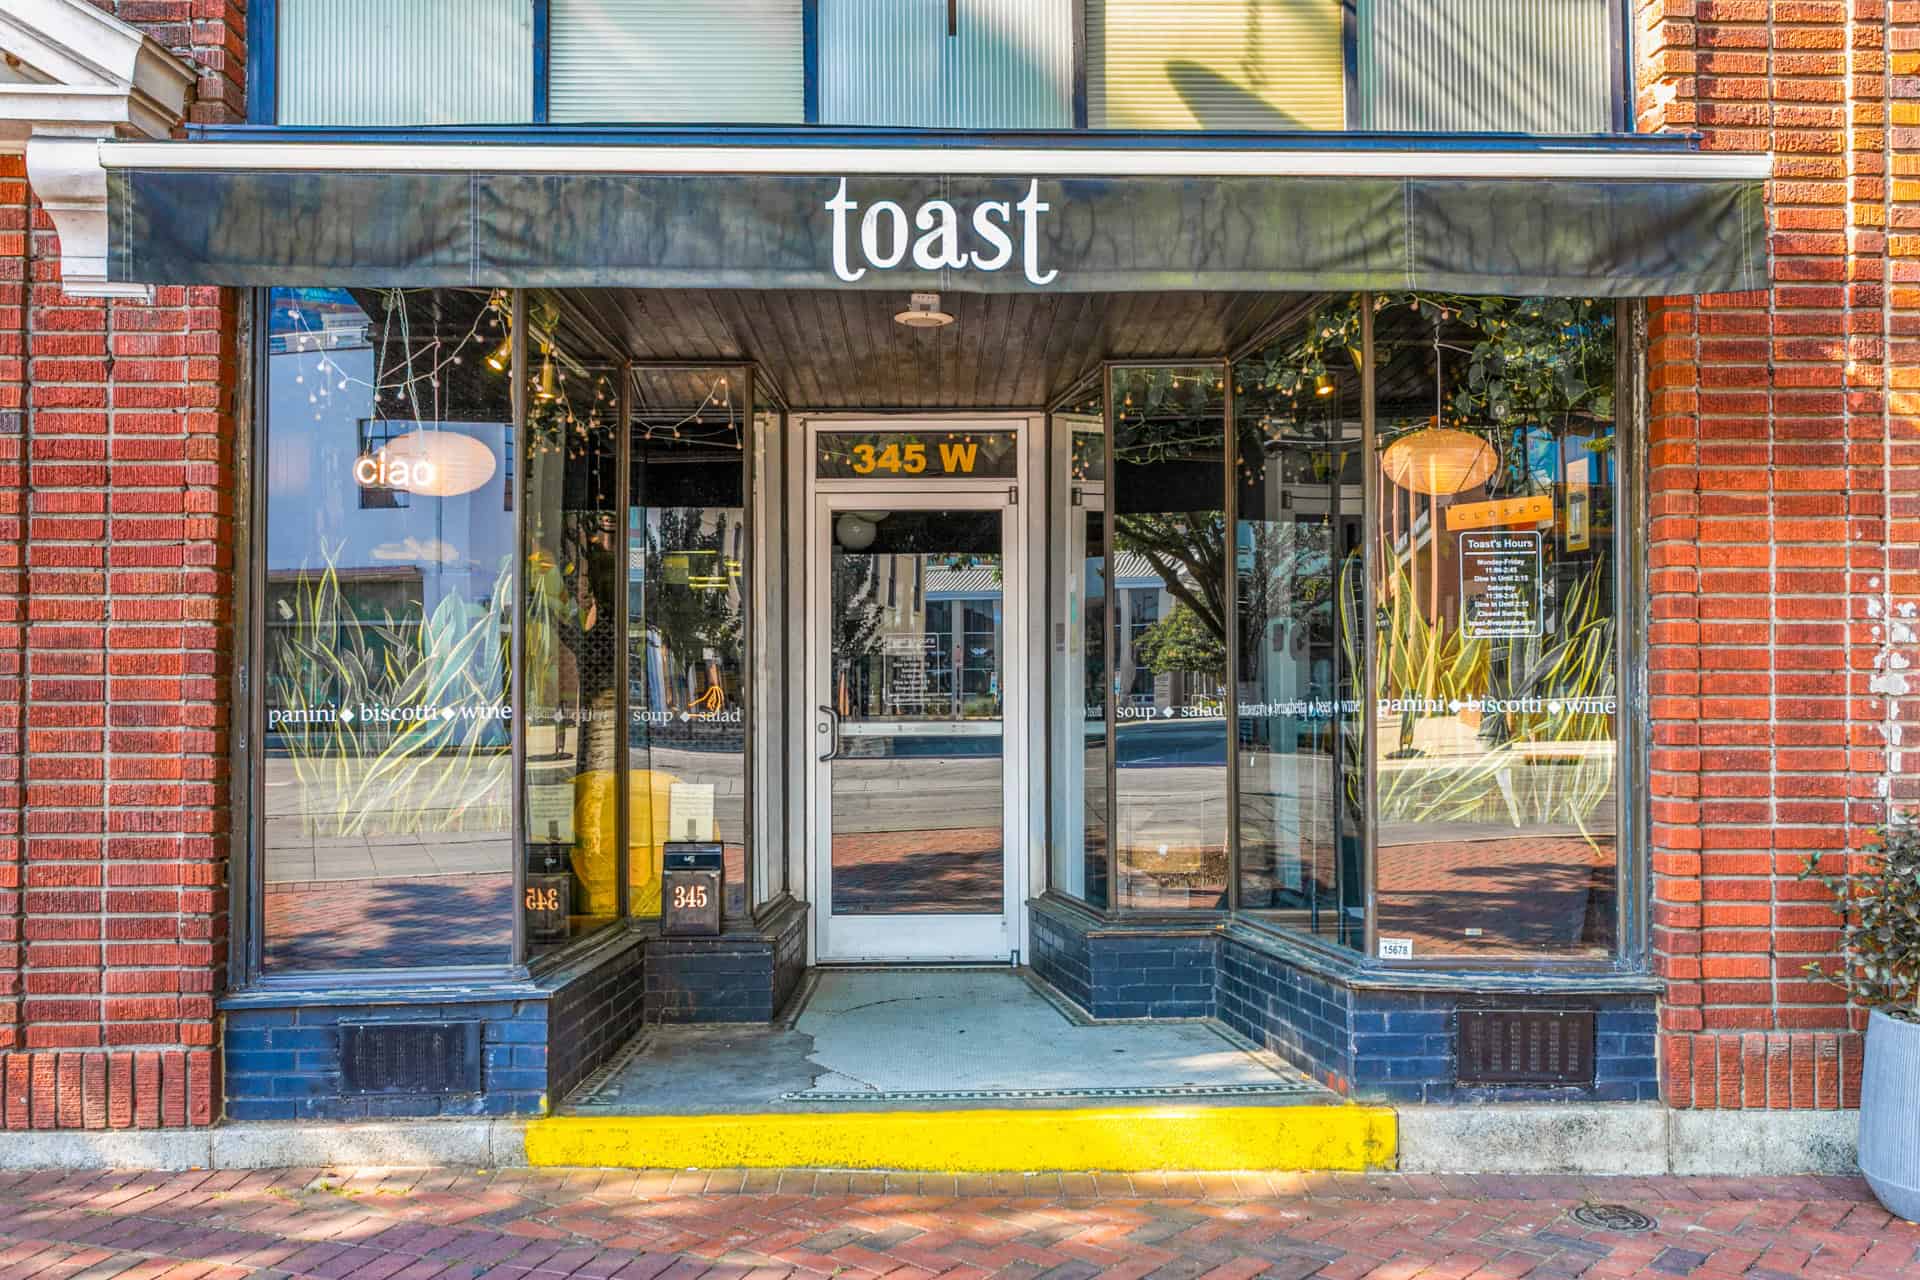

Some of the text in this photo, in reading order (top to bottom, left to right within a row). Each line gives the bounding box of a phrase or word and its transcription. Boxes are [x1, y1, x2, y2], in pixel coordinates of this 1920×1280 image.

[825, 176, 1058, 285] toast
[356, 450, 435, 486] ciao
[853, 443, 978, 474] 345 W
[1458, 504, 1541, 521] CLOSED
[1467, 538, 1534, 549] Toast's Hours
[268, 701, 337, 728] panini
[359, 701, 437, 722] biscotti
[460, 701, 513, 721] wine
[632, 707, 741, 726] soup salad
[1116, 706, 1157, 721] soup
[1181, 701, 1224, 718] salad
[1315, 695, 1332, 714] beer
[1341, 698, 1361, 713] wine
[1377, 693, 1616, 717] panini biscotti wine
[673, 885, 708, 909] 345
